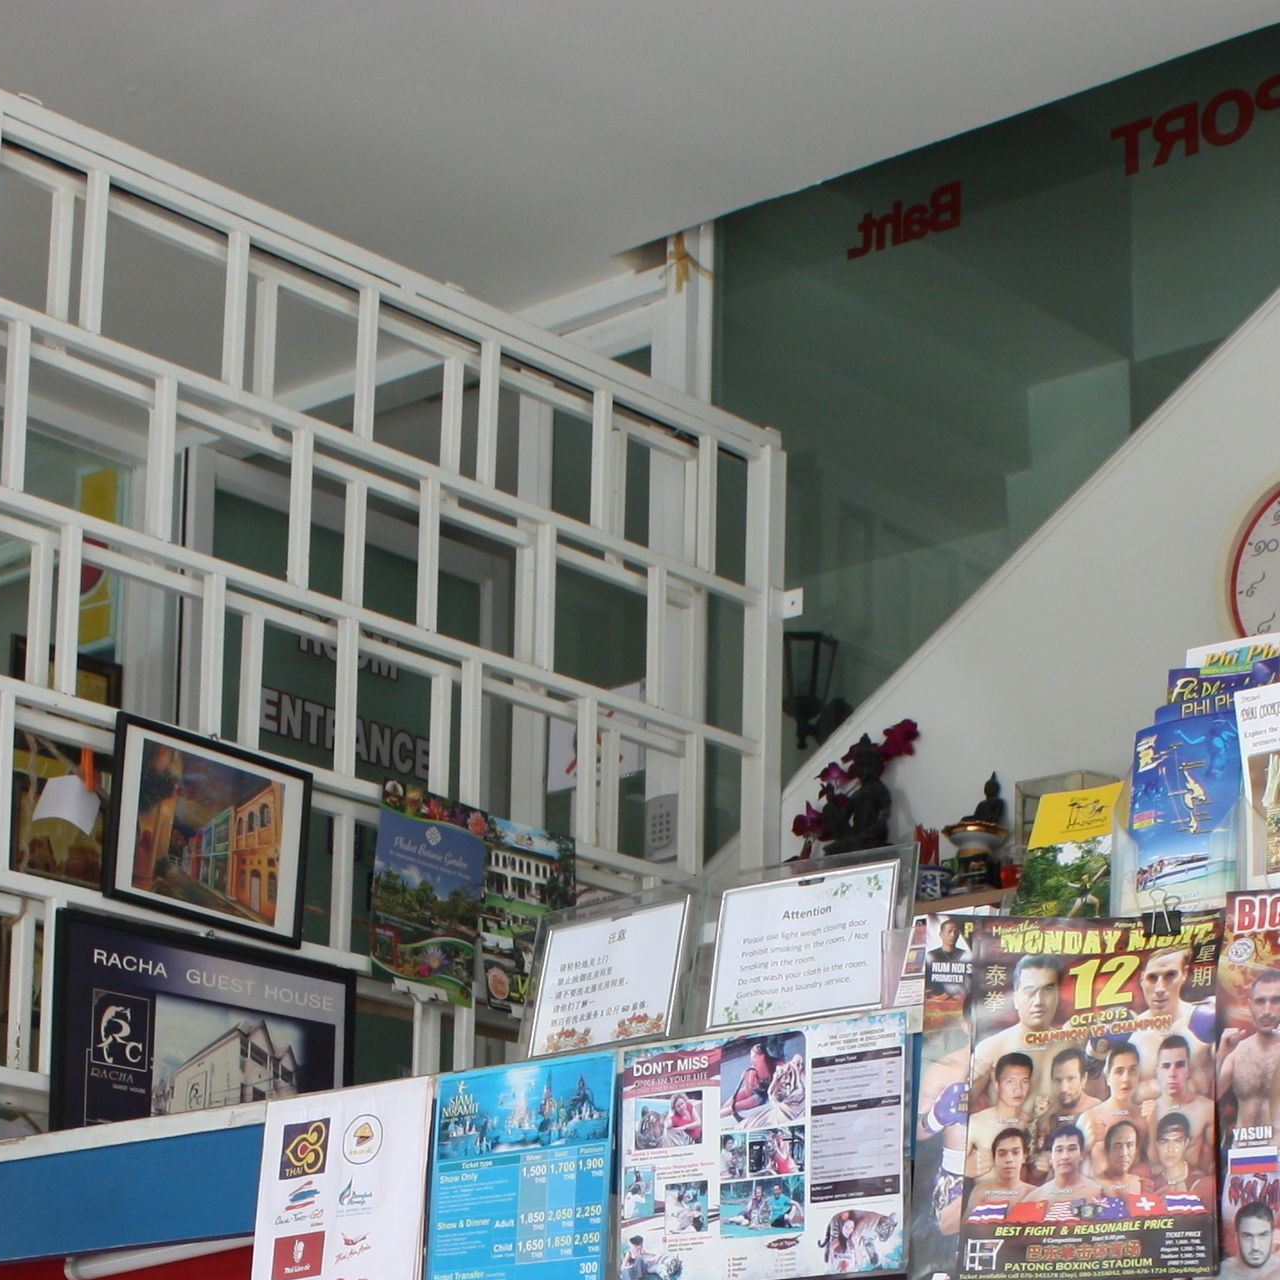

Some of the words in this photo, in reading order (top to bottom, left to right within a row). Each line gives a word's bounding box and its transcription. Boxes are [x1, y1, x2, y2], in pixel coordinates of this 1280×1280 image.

[781, 904, 833, 921] Attention
[769, 943, 803, 955] smoking
[1000, 927, 1124, 955] MONDAY
[92, 948, 168, 979] RACHA
[185, 968, 256, 996] GUEST
[264, 983, 336, 1013] HOUSE
[763, 973, 784, 982] wash
[784, 971, 802, 982] your
[930, 972, 964, 984] PROMOTER
[1069, 954, 1142, 1011] 12
[1069, 1011, 1095, 1027] OCT.
[1097, 1008, 1129, 1024] 2015
[1024, 1026, 1089, 1046] CHAMPION
[1109, 1013, 1173, 1036] CHAMPION
[632, 1059, 676, 1078] DON'T
[676, 1055, 710, 1072] MISS
[1232, 1125, 1274, 1143] YASUN
[284, 1166, 304, 1177] THAI
[521, 1165, 547, 1179] 1,500
[549, 1161, 576, 1175] 1,700
[578, 1157, 604, 1171] 1,900
[493, 1218, 516, 1229] Adult
[519, 1211, 546, 1225] 1,850
[547, 1207, 574, 1222] 2,050
[575, 1204, 603, 1219] 2,250
[994, 1225, 1022, 1238] BEST
[1023, 1224, 1056, 1237] FIGHT
[1073, 1220, 1142, 1236] REASONABLE
[1142, 1217, 1176, 1231] PRICE
[492, 1243, 514, 1254] Child
[517, 1238, 545, 1252] 1,650
[545, 1235, 573, 1249] 1,850
[573, 1231, 601, 1246] 2,050
[454, 1269, 485, 1280] Transfer
[578, 1261, 599, 1275] 300
[1003, 1261, 1054, 1272] PATONG
[1054, 1259, 1100, 1272] BOXING
[1102, 1257, 1153, 1271] STADIUM
